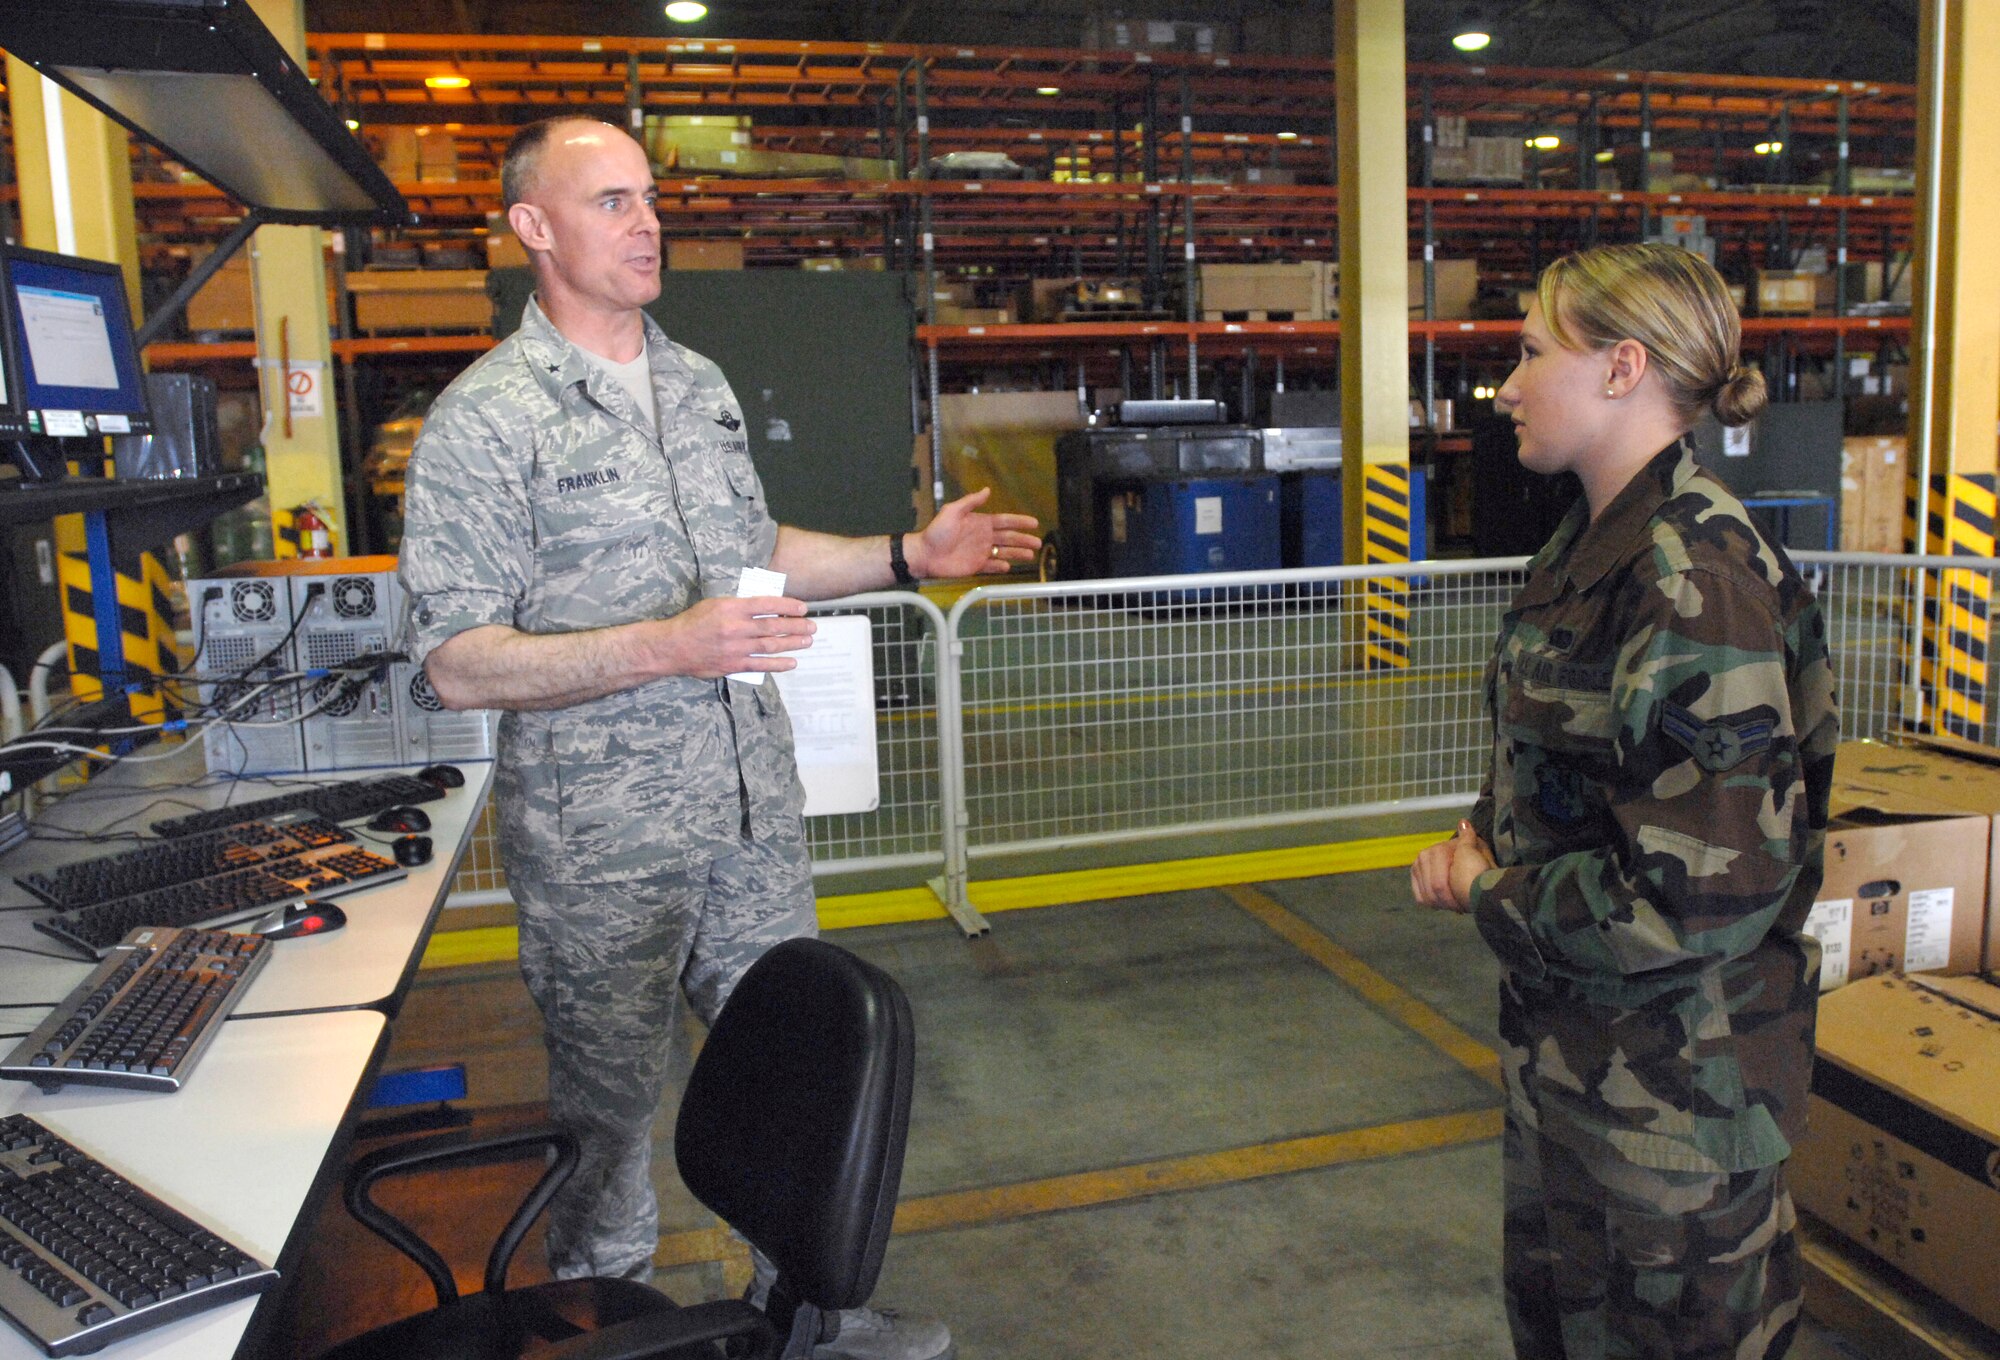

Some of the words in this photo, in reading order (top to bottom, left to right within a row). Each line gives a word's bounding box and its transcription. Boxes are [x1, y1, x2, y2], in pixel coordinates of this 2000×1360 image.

[557, 467, 621, 493] FRANKLIN
[1532, 660, 1553, 684] AIR
[1558, 664, 1613, 691] FORCE
